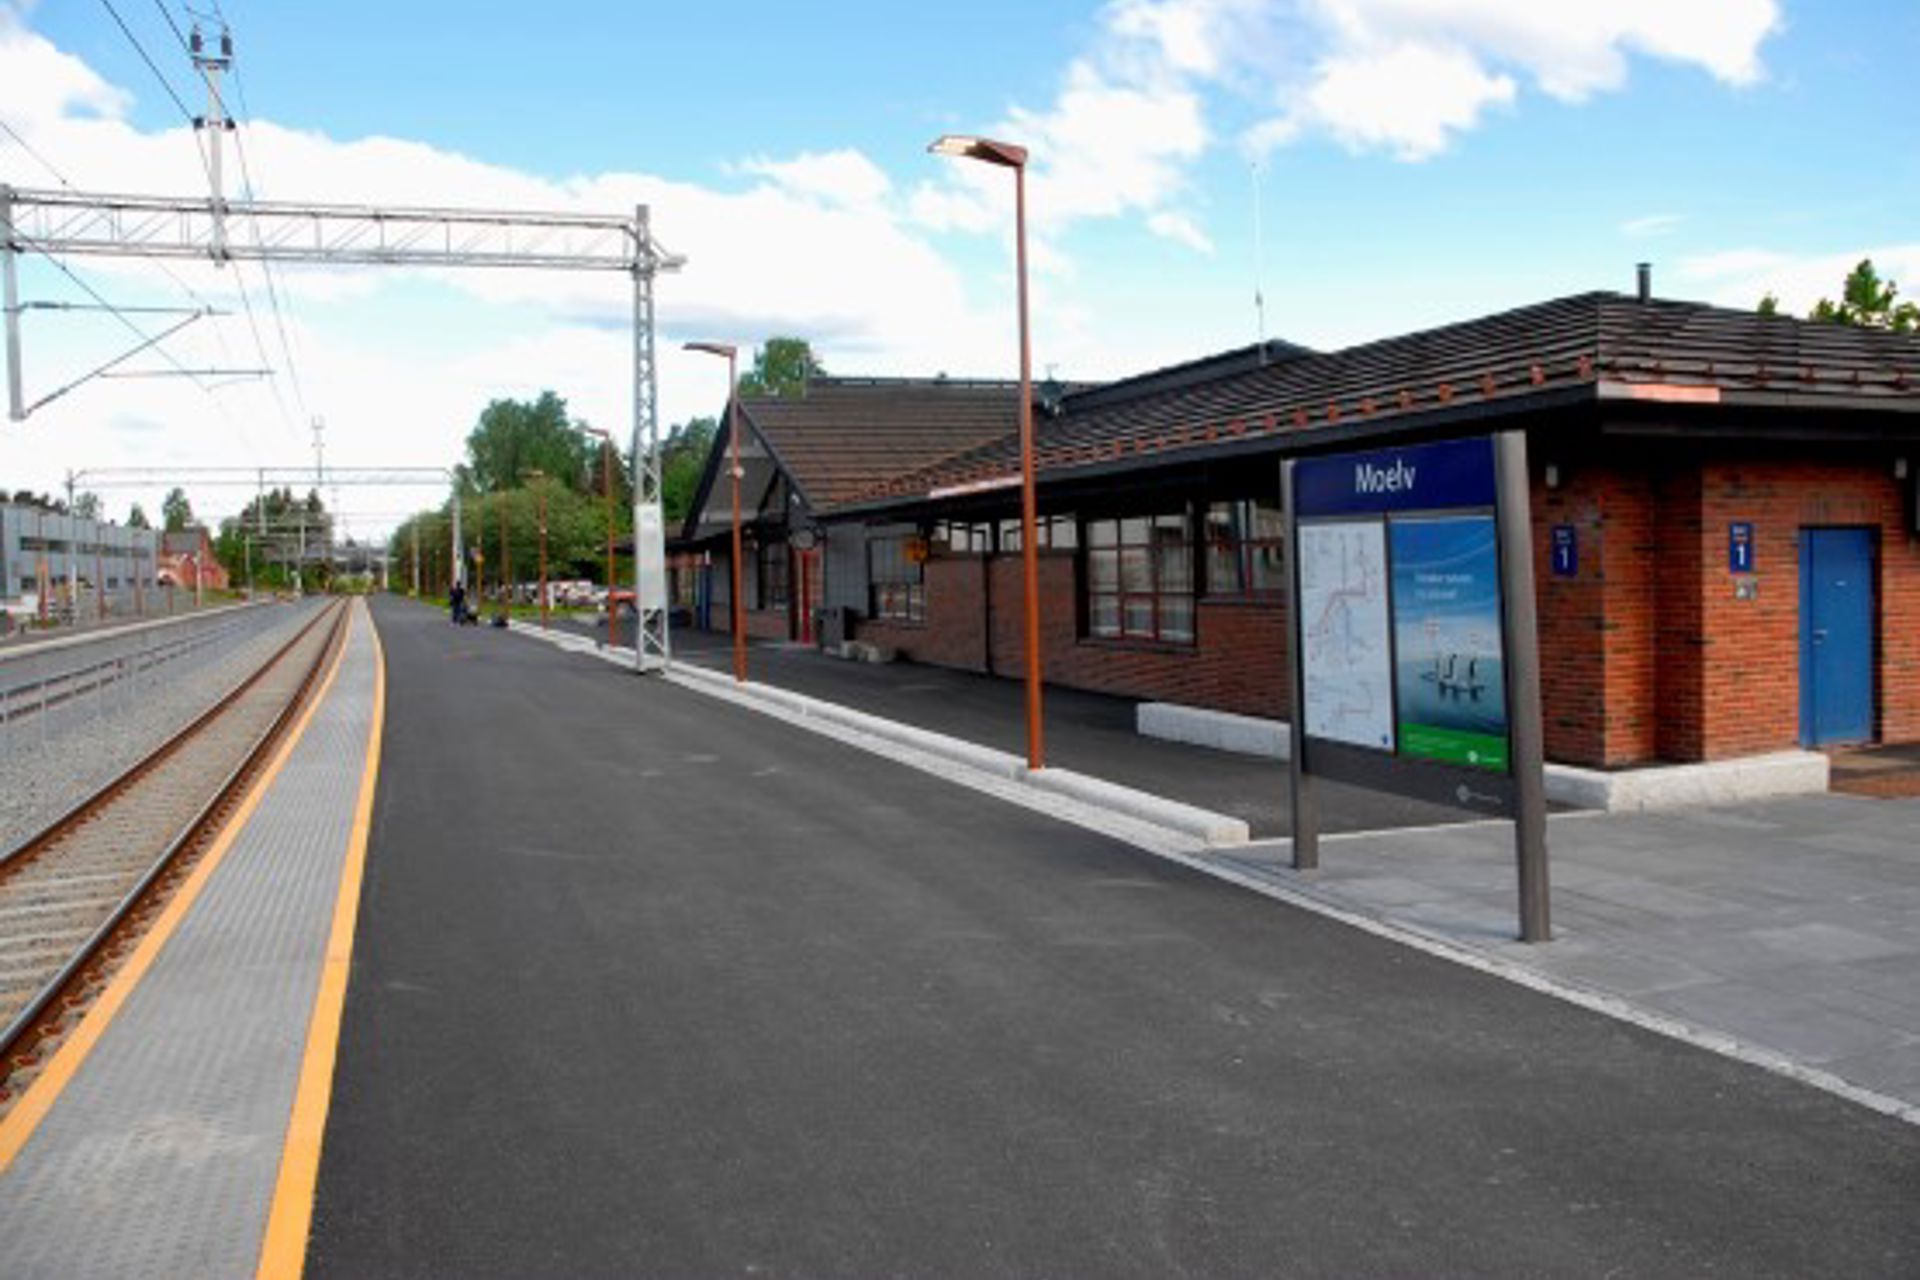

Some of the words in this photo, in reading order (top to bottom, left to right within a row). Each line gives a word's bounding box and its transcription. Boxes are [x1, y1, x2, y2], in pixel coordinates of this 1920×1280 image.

[1355, 459, 1416, 493] Moelv
[1560, 546, 1568, 569] 1
[1736, 544, 1745, 566] 1
